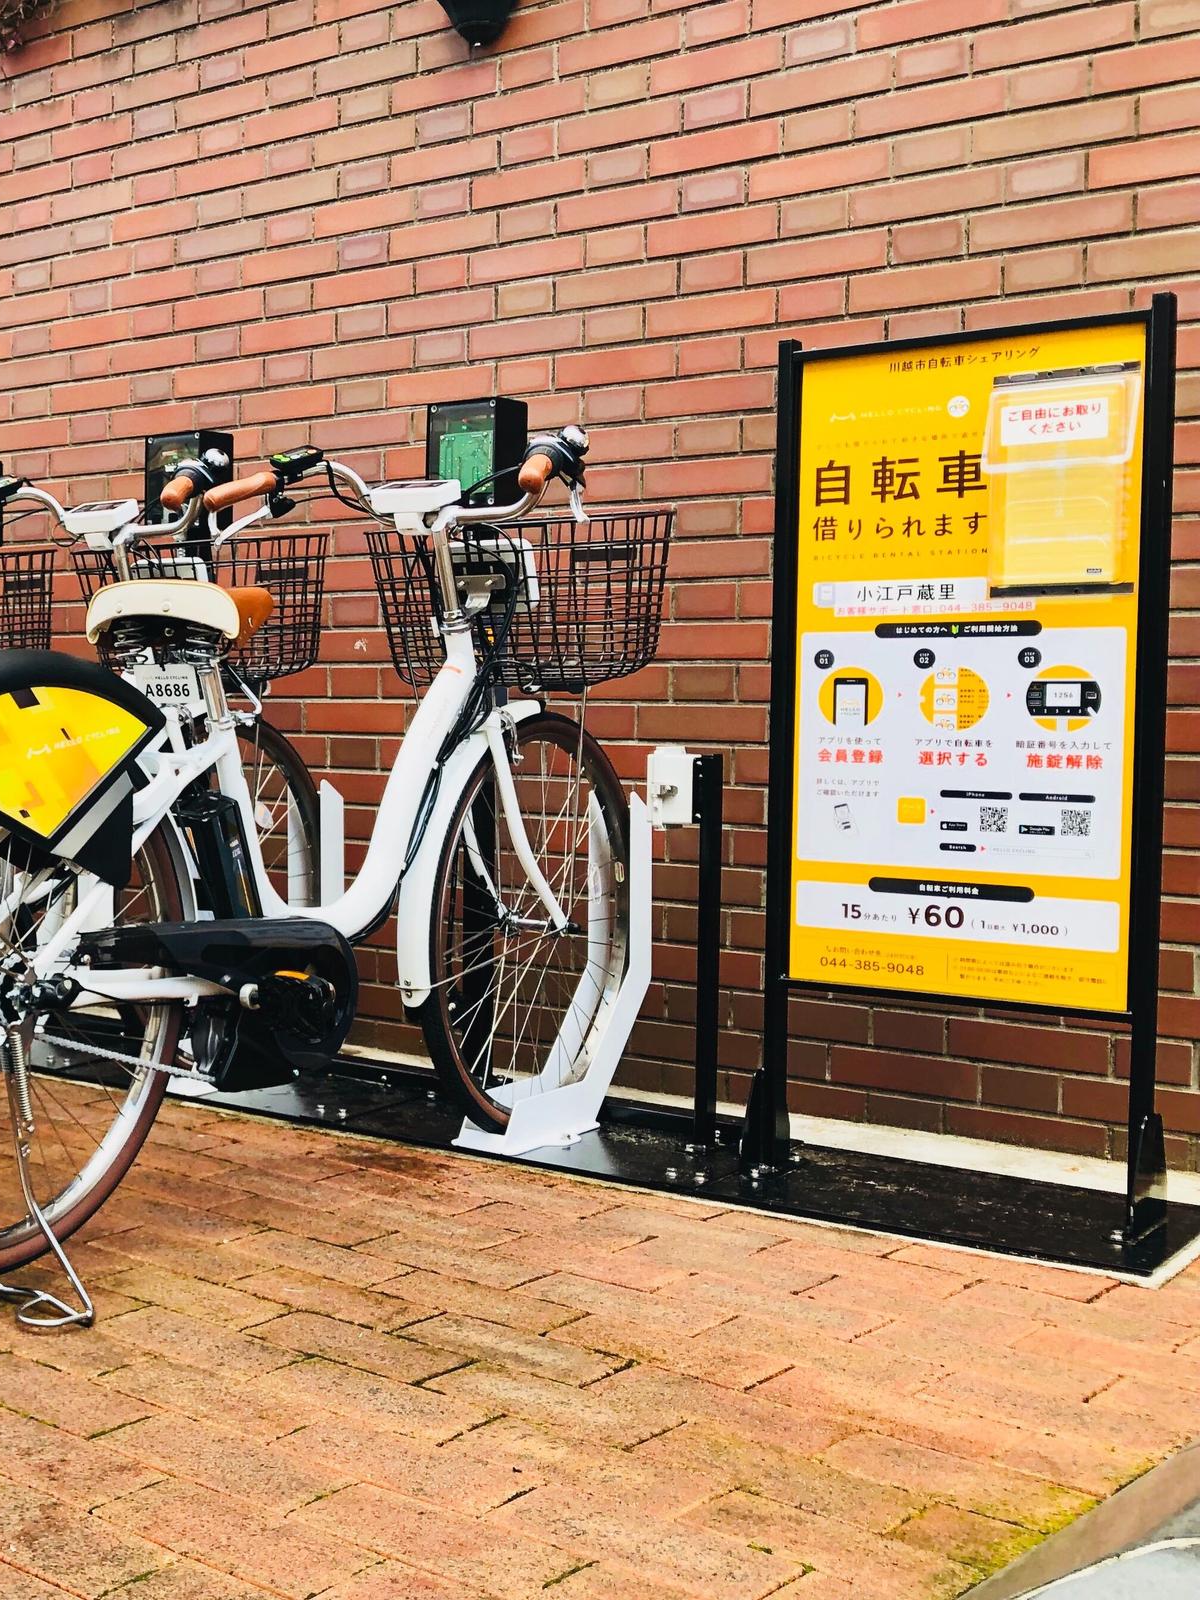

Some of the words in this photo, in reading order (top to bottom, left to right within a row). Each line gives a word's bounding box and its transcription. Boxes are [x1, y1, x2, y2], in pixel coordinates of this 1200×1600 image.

[889, 346, 1041, 373] 川越市自転車シェアリング
[1008, 402, 1102, 422] ご自由にお取り
[1028, 421, 1082, 435] ください
[815, 450, 988, 507] 自転車
[812, 511, 988, 542] 借りられます
[856, 583, 957, 602] 小江戸蔵里
[1024, 656, 1036, 664] 03
[145, 683, 190, 697] A8686
[817, 735, 882, 746] アプリを使って
[914, 738, 993, 748] アプリで自転車を
[1015, 740, 1112, 751] 暗証番号を入力して
[817, 748, 884, 764] 会員登録
[918, 751, 989, 767] 選択する
[1026, 753, 1104, 770] 施錠解除
[907, 904, 965, 929] ¥60
[820, 956, 925, 976] 044-385-9048
